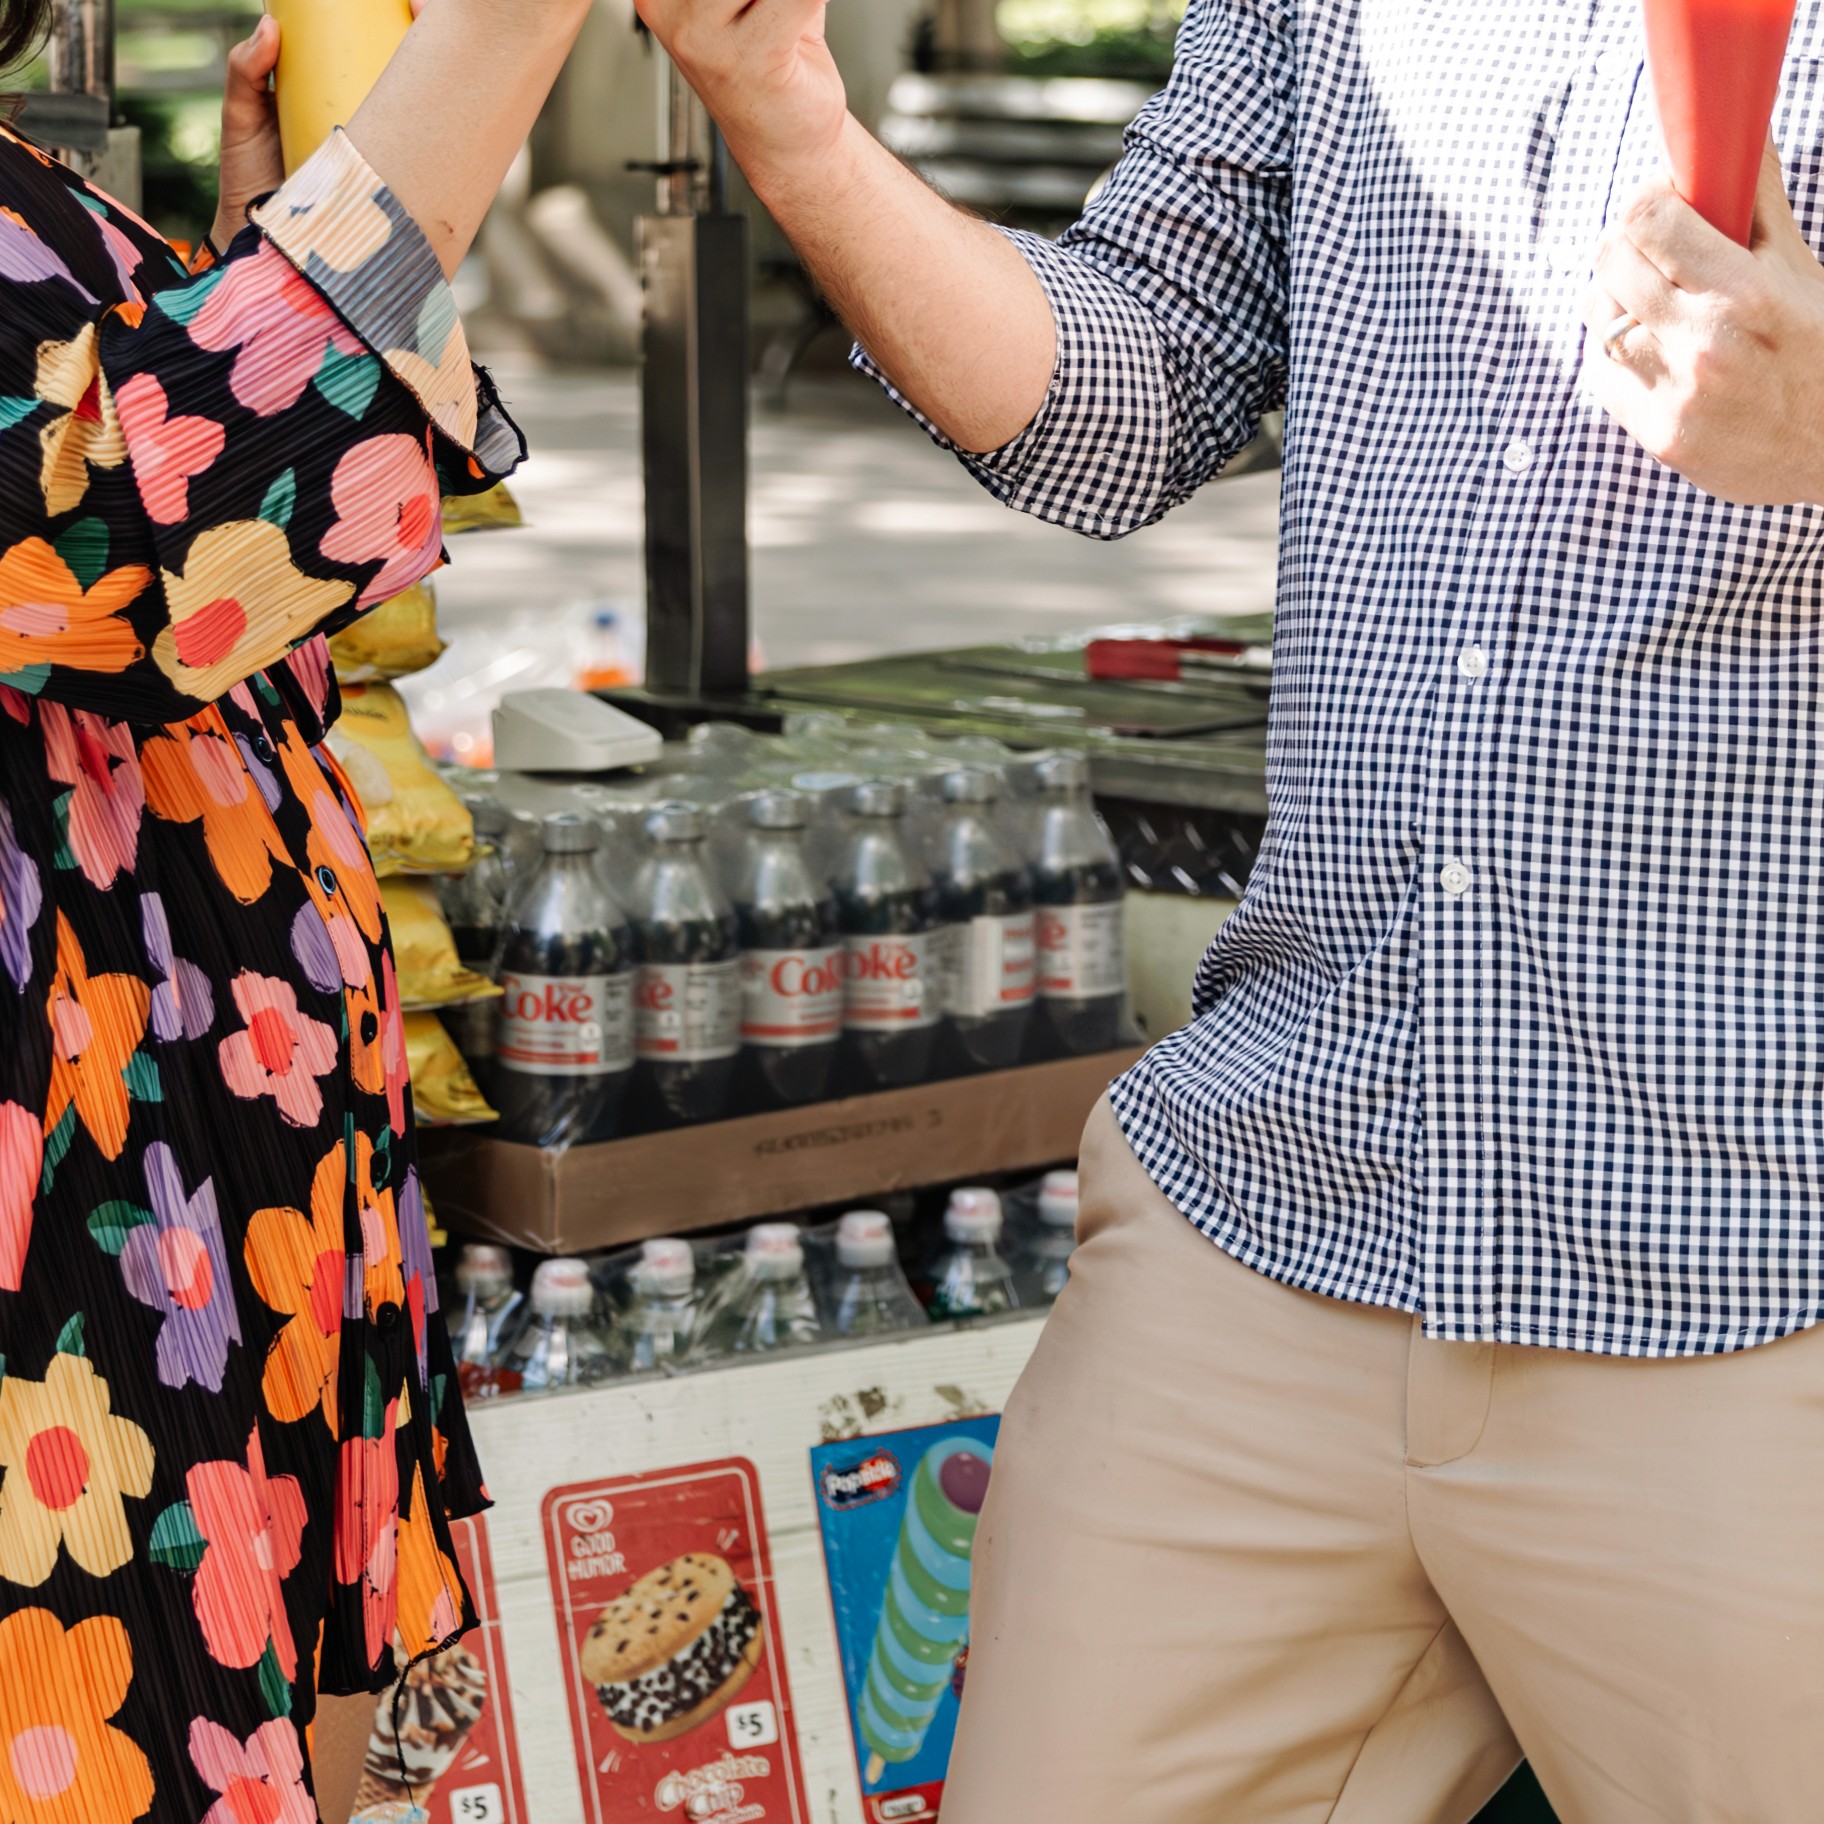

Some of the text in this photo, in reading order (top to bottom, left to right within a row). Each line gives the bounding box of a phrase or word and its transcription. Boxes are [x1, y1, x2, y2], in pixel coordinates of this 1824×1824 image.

[570, 1533, 617, 1560] GOOD
[736, 1711, 763, 1738] $5
[460, 1794, 488, 1821] $5
